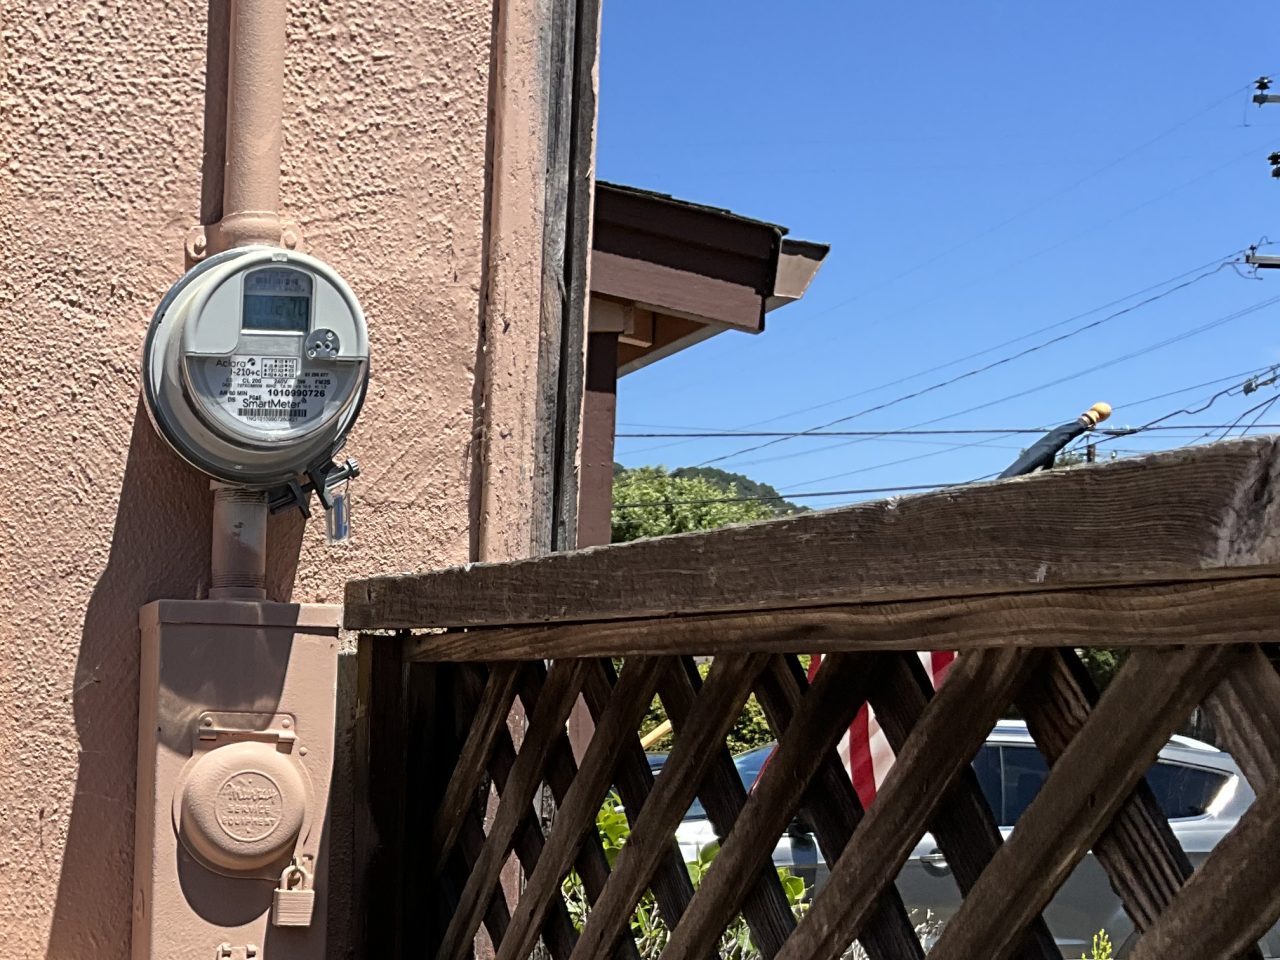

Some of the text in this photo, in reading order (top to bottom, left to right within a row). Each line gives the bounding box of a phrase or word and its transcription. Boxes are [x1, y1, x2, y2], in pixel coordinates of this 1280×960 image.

[216, 359, 246, 368] Aclara
[268, 389, 325, 397] 1010990726
[243, 399, 301, 409] SmartMeter
